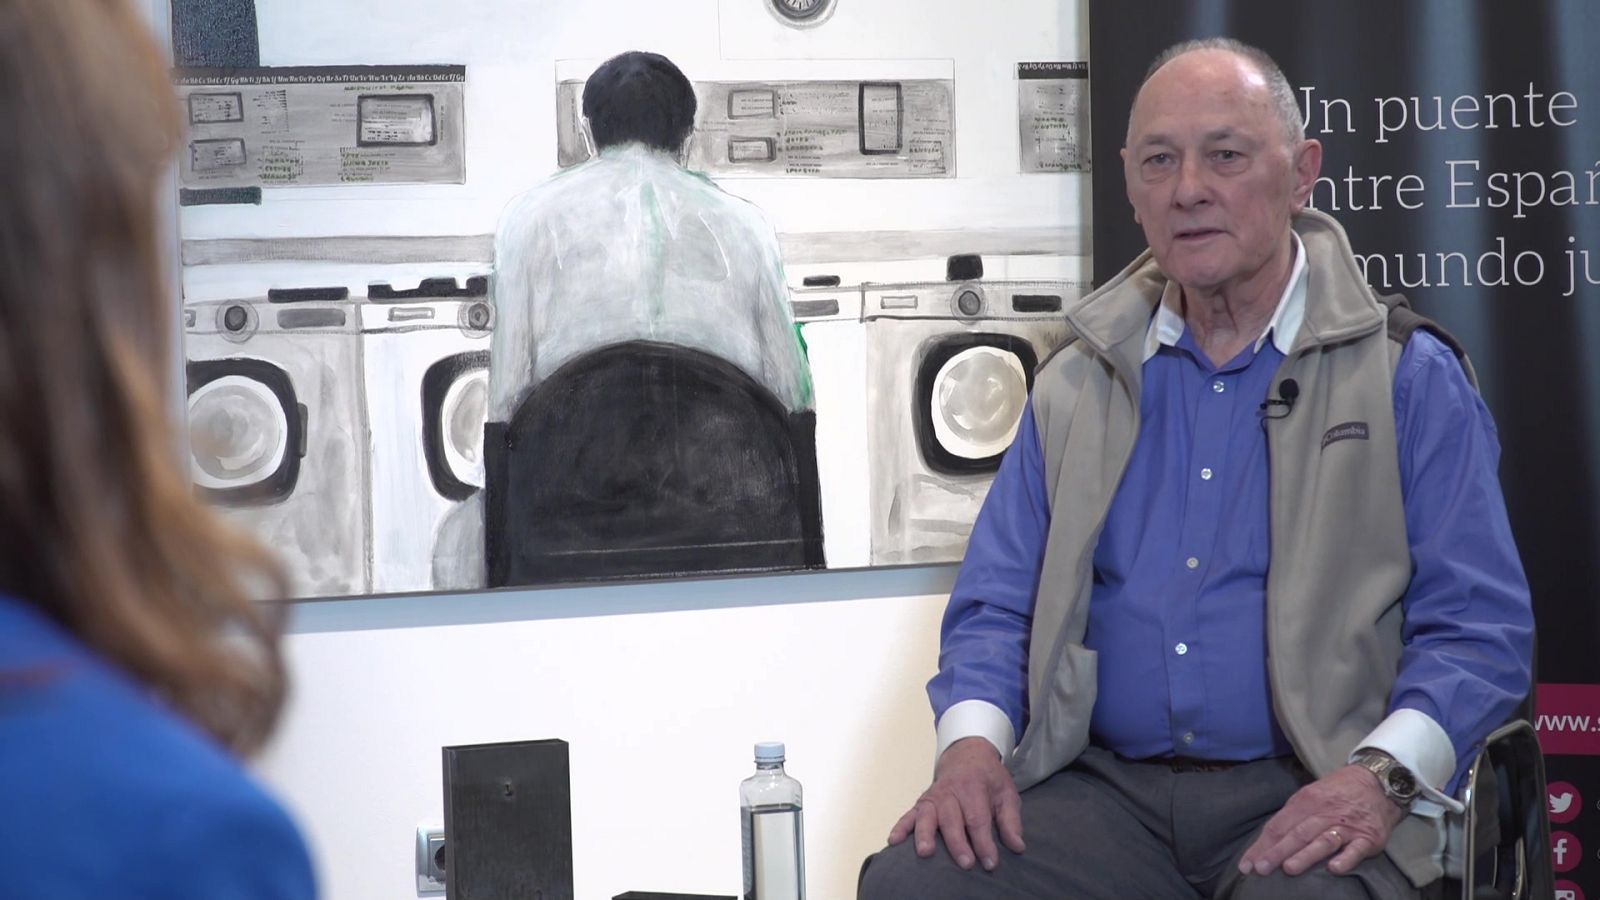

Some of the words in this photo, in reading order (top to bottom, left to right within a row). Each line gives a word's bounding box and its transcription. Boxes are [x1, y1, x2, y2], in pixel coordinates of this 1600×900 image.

[1374, 81, 1578, 143] puente
[1308, 165, 1425, 211] ntre
[1352, 237, 1545, 288] mundo
